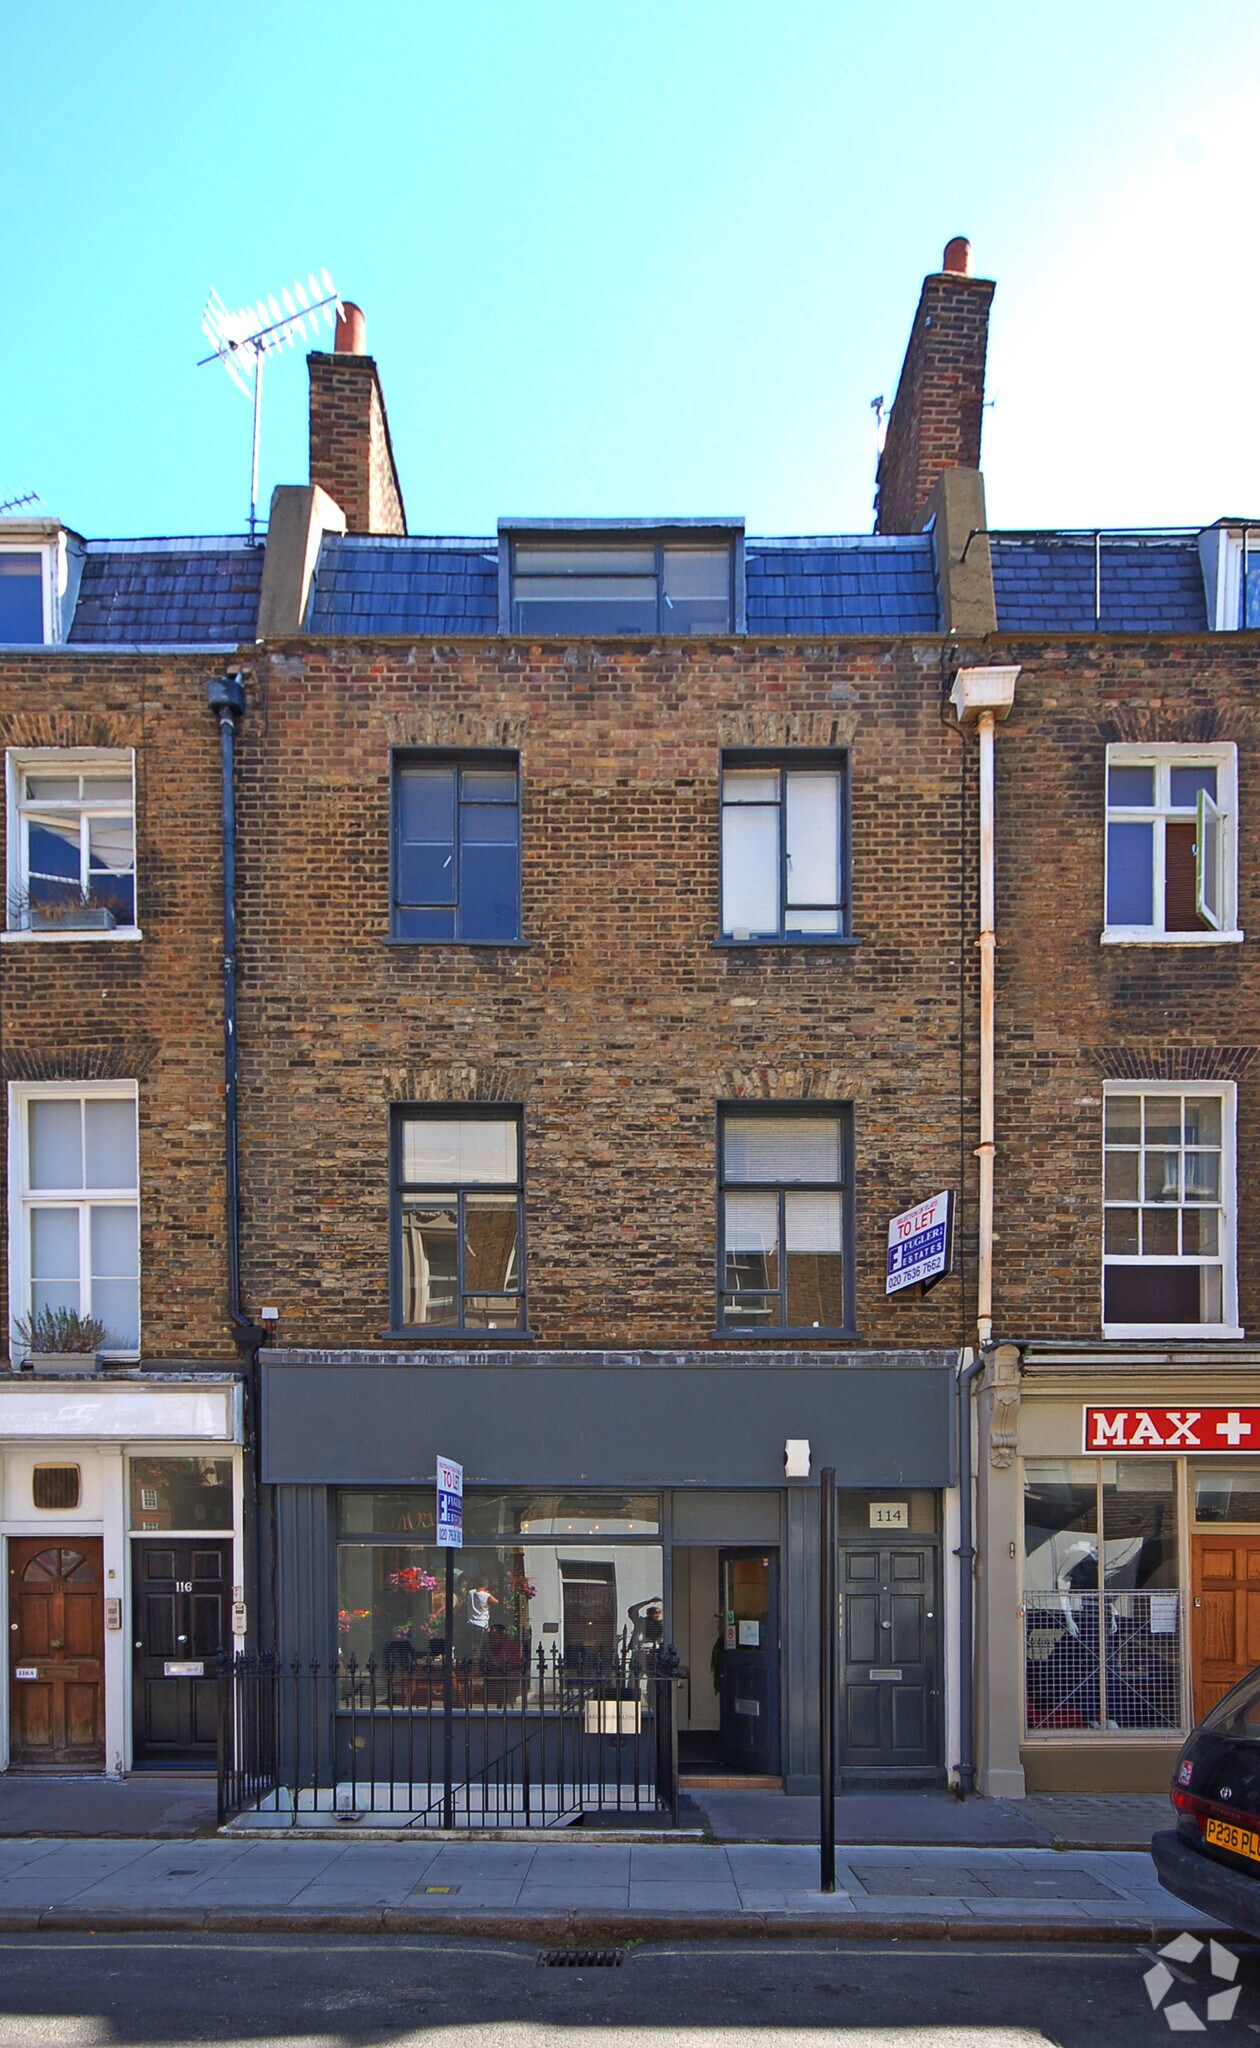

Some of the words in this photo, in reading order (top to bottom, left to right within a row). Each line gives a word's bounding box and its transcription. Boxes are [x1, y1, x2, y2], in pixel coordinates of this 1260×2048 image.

[898, 1221, 911, 1239] TO
[914, 1208, 936, 1232] LET
[902, 1241, 942, 1266] ESTATES
[888, 1274, 902, 1288] 020
[1092, 1412, 1202, 1446] MAX
[443, 1470, 452, 1488] TO
[877, 1510, 902, 1521] 114
[175, 1581, 193, 1592] 116
[1208, 1821, 1239, 1847] P236
[1241, 1832, 1260, 1857] PL
